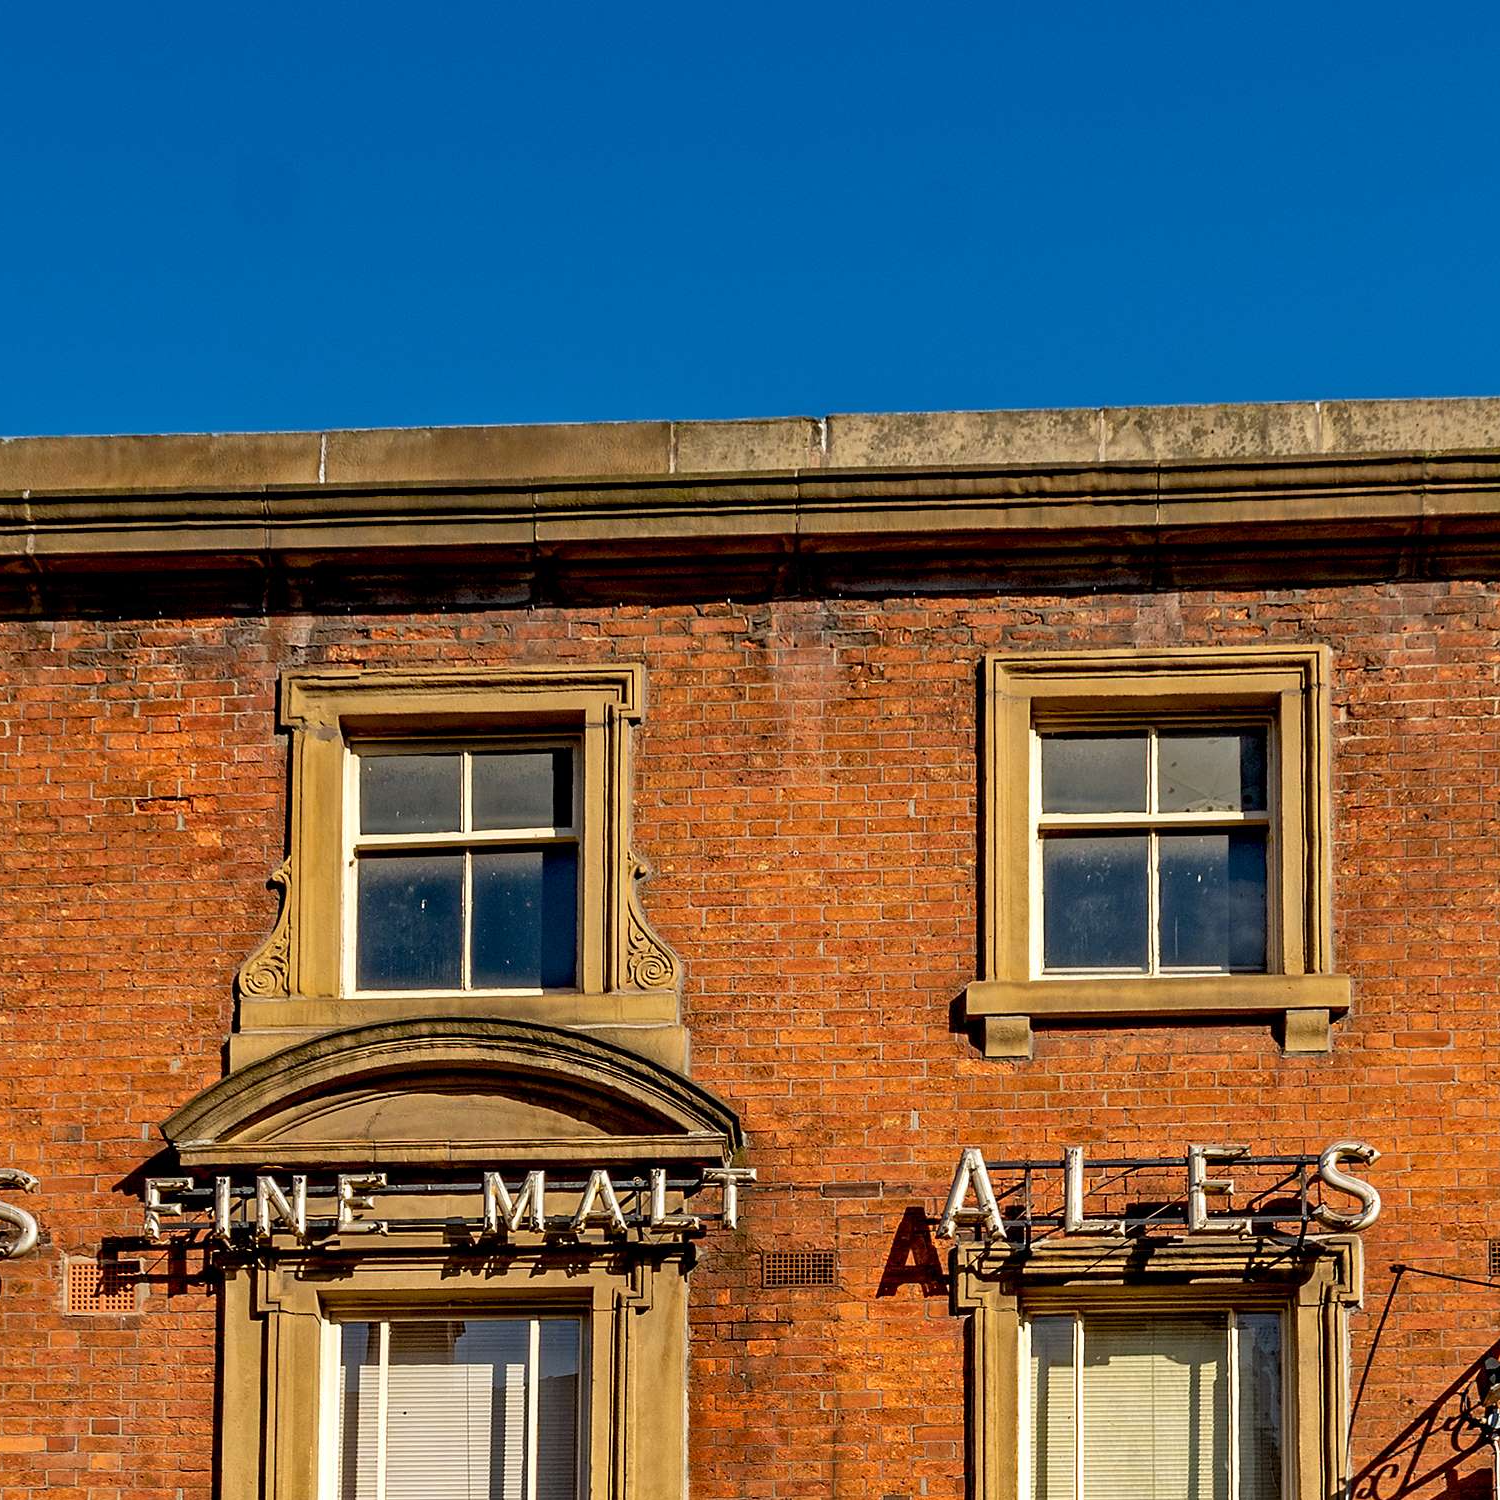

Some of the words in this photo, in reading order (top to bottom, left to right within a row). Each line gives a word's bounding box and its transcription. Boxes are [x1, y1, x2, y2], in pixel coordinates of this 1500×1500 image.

[143, 1170, 389, 1245] FINE
[483, 1167, 758, 1236] MALT
[937, 1140, 1382, 1240] ALES
